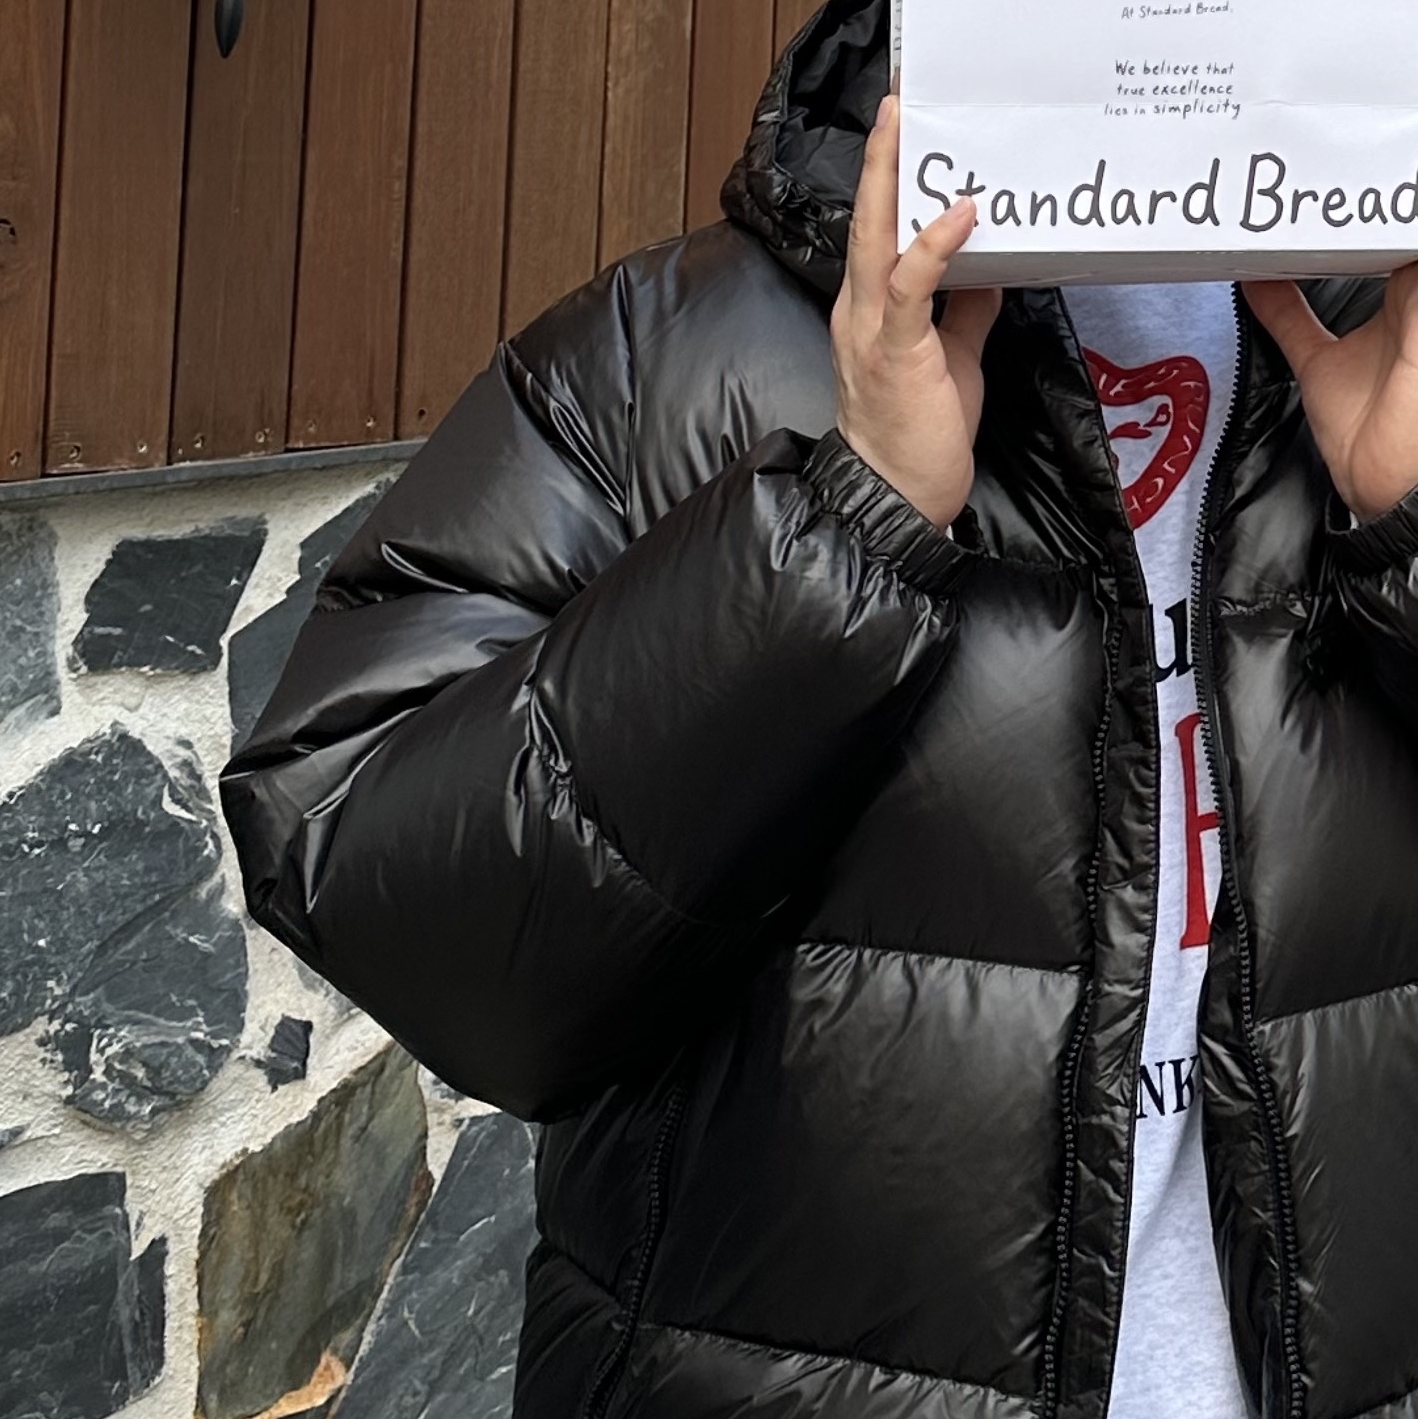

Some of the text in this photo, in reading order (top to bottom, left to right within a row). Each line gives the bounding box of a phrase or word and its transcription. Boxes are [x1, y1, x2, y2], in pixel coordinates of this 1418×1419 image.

[1120, 6, 1135, 20] At
[1138, 2, 1192, 19] Standard
[1115, 59, 1235, 76] We believe that
[1117, 78, 1234, 96] true excellence
[1104, 98, 1242, 121] lies in simplicity
[911, 152, 1221, 234] Standard
